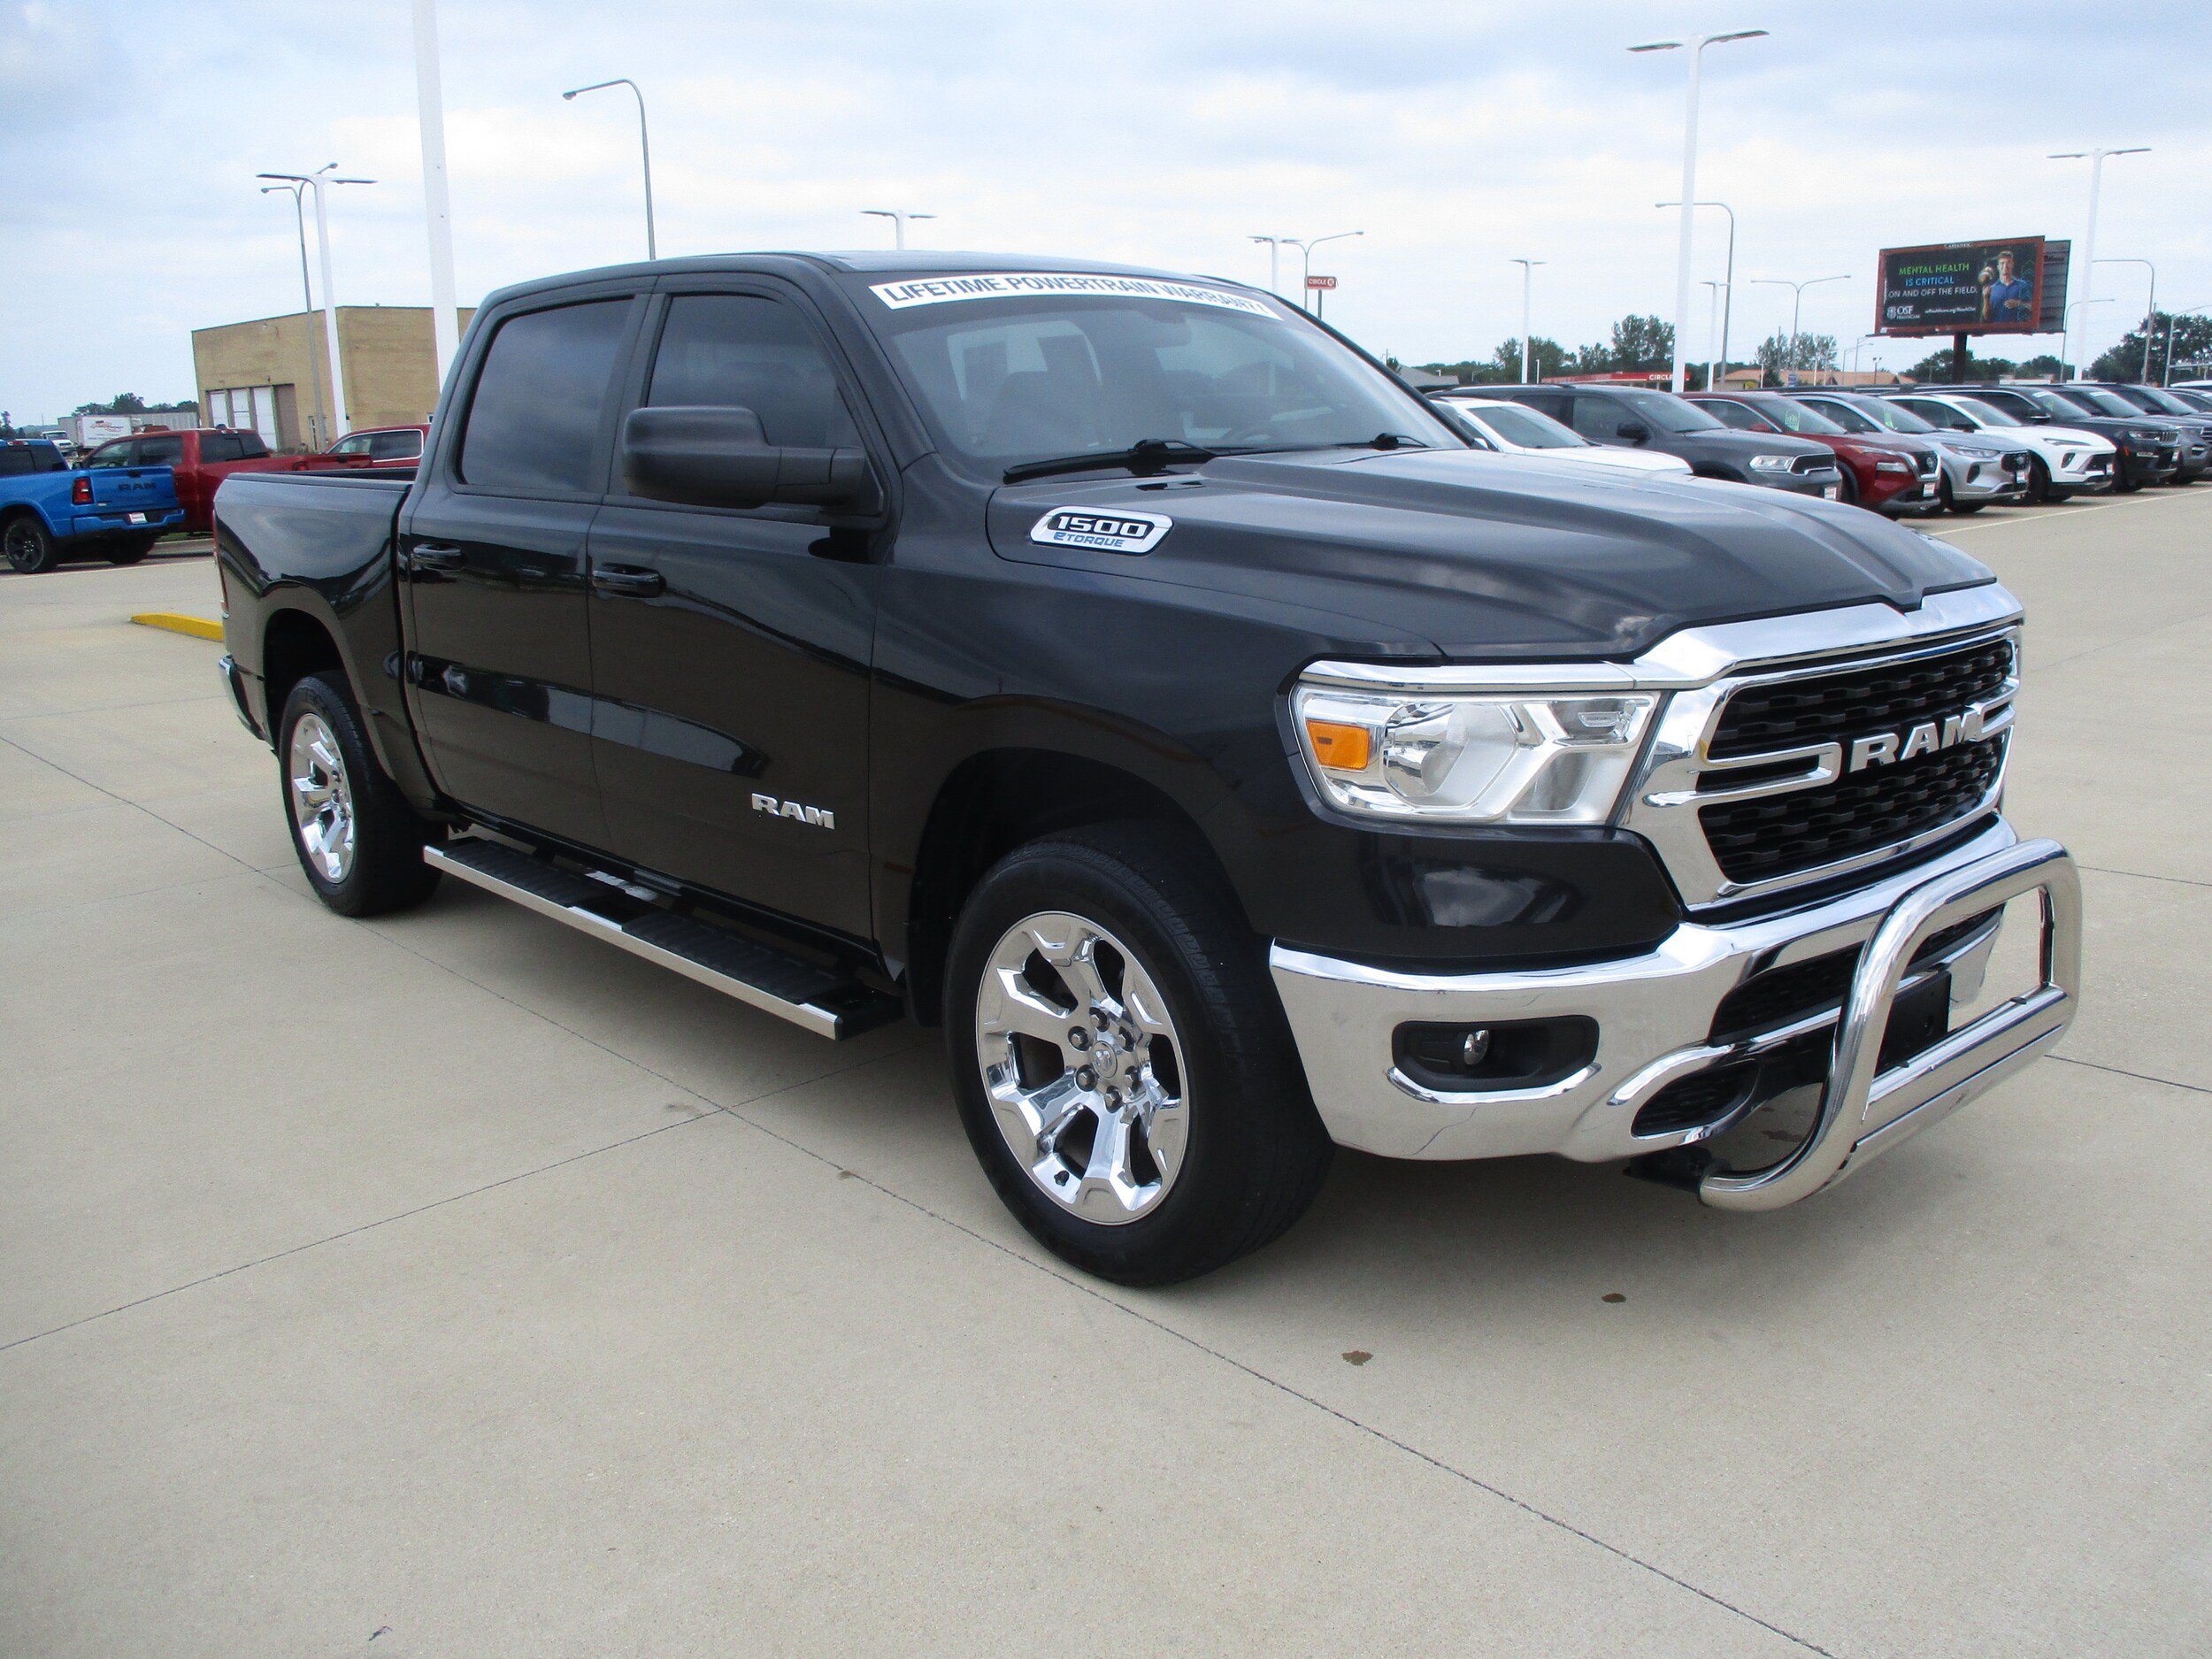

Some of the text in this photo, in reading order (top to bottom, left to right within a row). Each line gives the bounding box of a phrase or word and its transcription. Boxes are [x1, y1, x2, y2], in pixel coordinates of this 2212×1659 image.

[1899, 263, 1970, 275] MENTAL HEALTH
[883, 277, 1008, 302] LIFETIME
[1004, 277, 1154, 294] POWERTRAIN
[1905, 276, 1955, 287] IS CRITICAL
[1897, 305, 1914, 315] OSF
[119, 481, 156, 491] RAM
[1057, 516, 1148, 537] 1500
[1849, 709, 1984, 773] RAM
[751, 793, 835, 830] RAM
